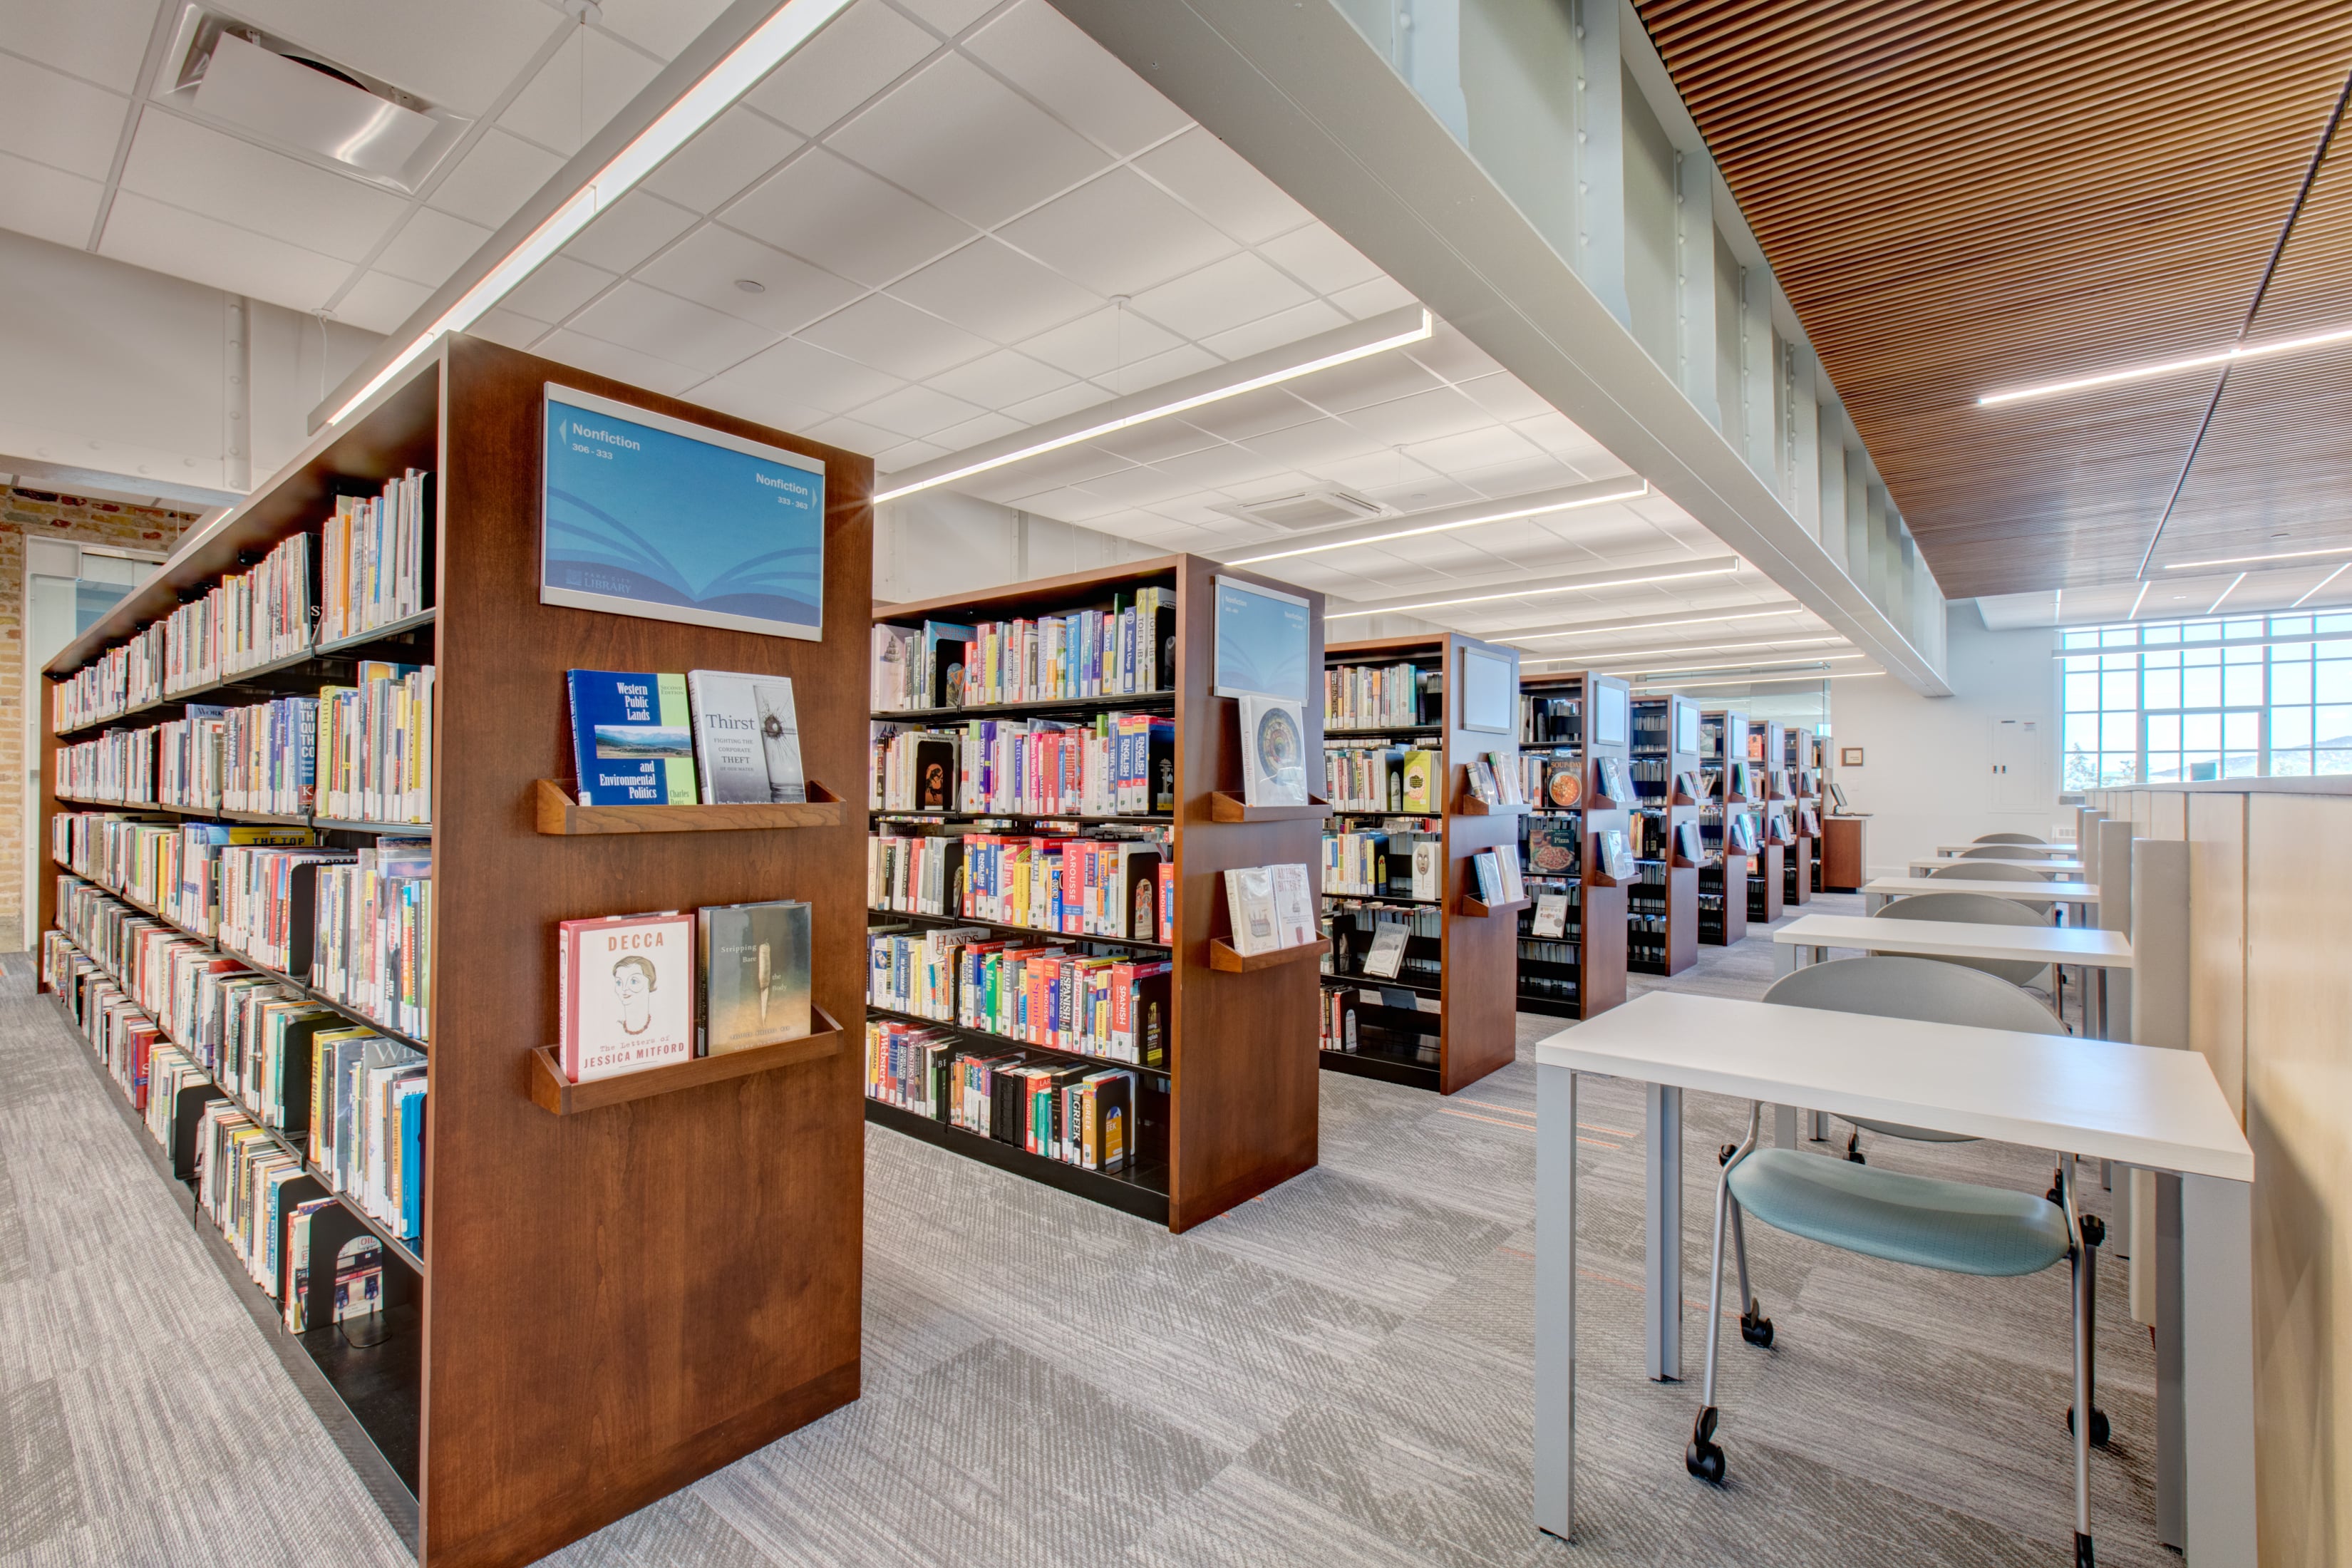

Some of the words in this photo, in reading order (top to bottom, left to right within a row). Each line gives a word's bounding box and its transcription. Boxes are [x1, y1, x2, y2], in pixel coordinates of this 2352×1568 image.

[572, 422, 641, 452] Nonfiction
[572, 443, 590, 455] 306
[596, 448, 614, 460] 333
[755, 473, 808, 496] Nonfiction
[777, 496, 791, 507] 333
[795, 499, 809, 510] 363
[584, 577, 631, 594] LIBRARY
[616, 681, 648, 696] Western
[300, 701, 314, 711] THE
[624, 695, 649, 708] Public
[626, 708, 651, 721] Lands
[706, 713, 756, 731] Thirst
[639, 760, 654, 773] and
[721, 755, 750, 764] THEFT
[599, 773, 656, 786] Environmental
[629, 786, 657, 799] Politics
[669, 789, 690, 799] Charles
[1068, 850, 1077, 901] LAROUSSE
[607, 931, 664, 952] DECCA
[721, 944, 758, 954] Stripping
[935, 934, 979, 951] HANDS
[772, 984, 788, 992] Body
[1063, 976, 1071, 1020] SPANISH
[1032, 982, 1041, 1033] Spanish
[599, 1043, 614, 1053] The
[619, 1038, 656, 1051] Letters
[660, 1034, 671, 1043] of
[583, 1046, 631, 1069] JESSICA
[636, 1041, 685, 1061] MITFORD
[879, 1037, 889, 1088] Webster's
[1106, 1122, 1117, 1133] EEK
